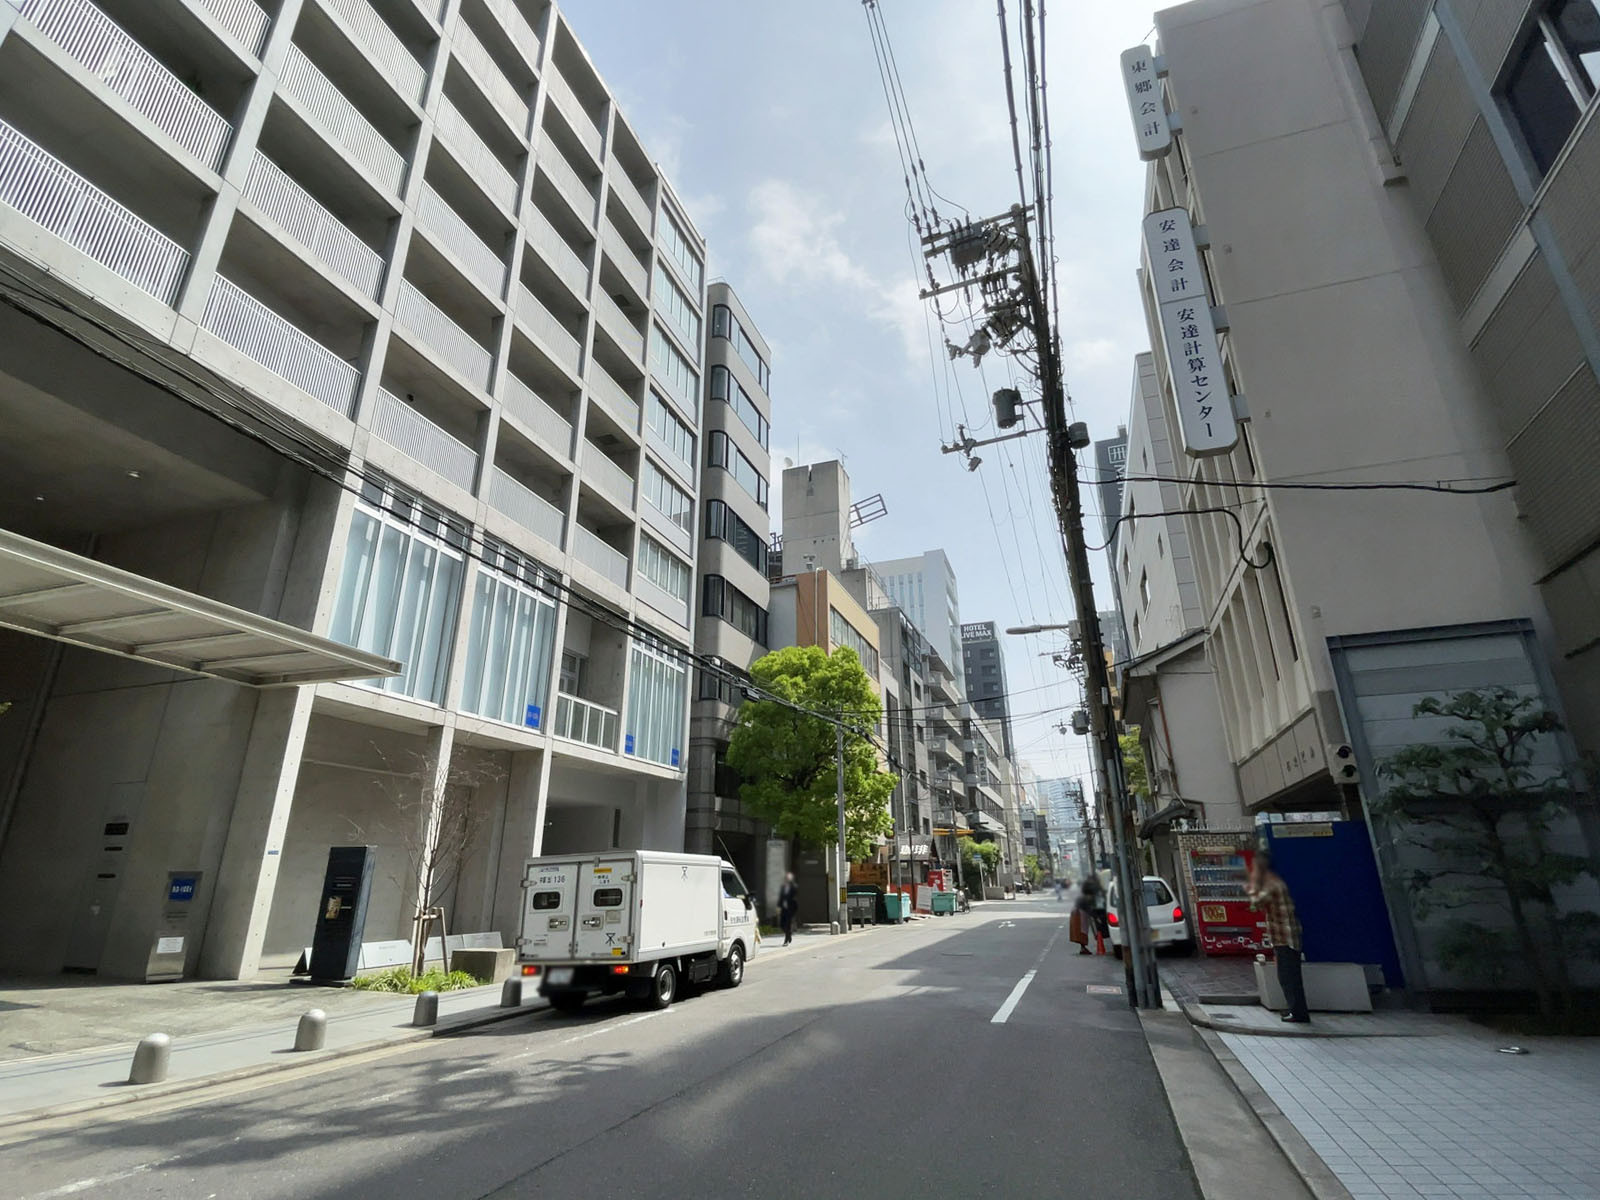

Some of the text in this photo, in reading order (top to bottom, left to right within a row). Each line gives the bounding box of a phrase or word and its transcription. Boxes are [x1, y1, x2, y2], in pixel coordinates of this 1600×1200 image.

[1131, 60, 1160, 137] 東郷会計
[1159, 219, 1188, 292] 安達会計
[1177, 308, 1214, 438] 安達計算センター
[963, 624, 986, 632] HOTEL
[900, 844, 929, 855] 珈琲
